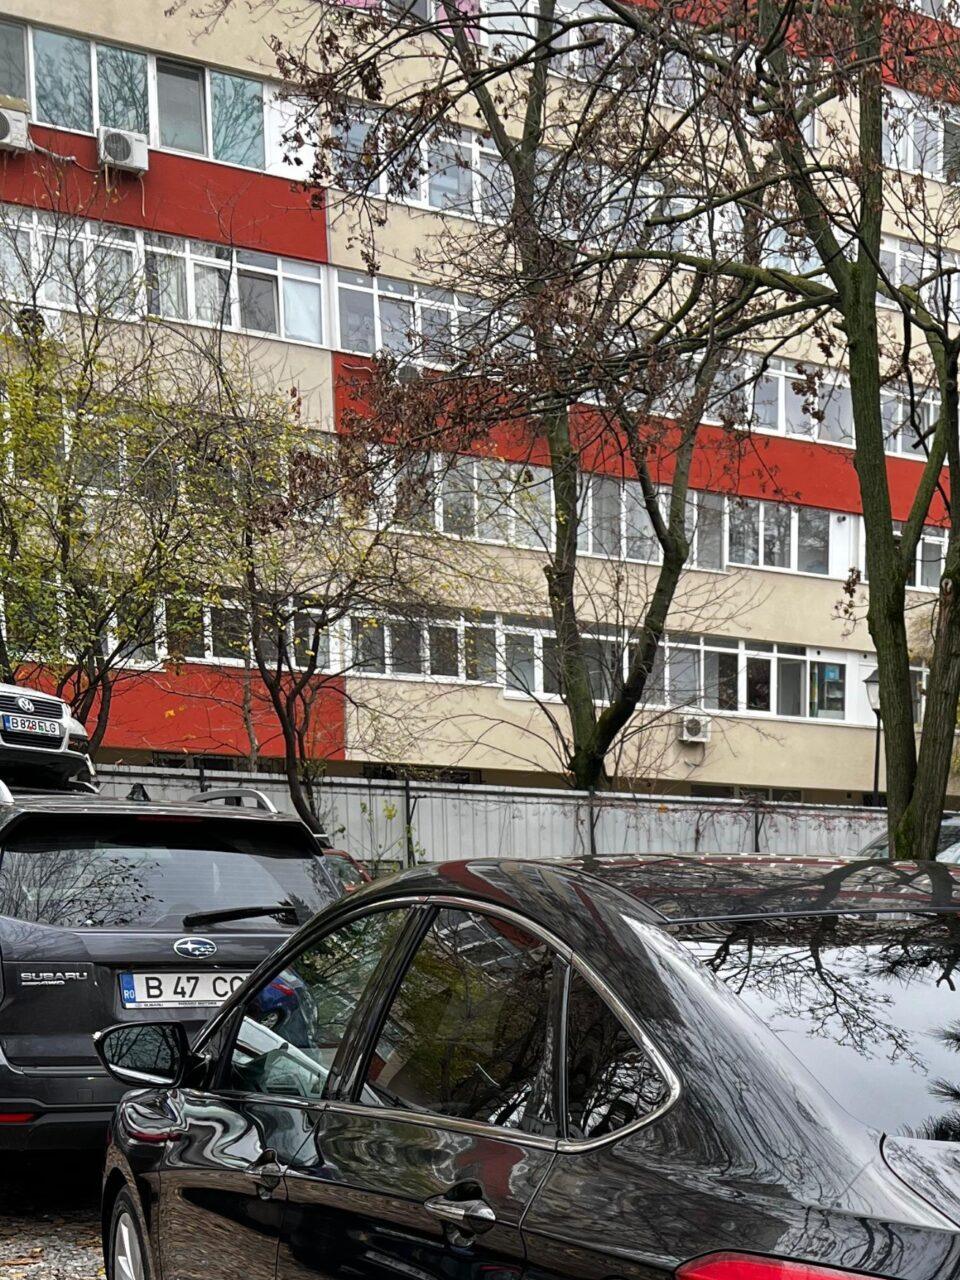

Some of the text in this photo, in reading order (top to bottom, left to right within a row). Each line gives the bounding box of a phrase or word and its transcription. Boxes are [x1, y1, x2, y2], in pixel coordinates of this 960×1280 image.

[12, 718, 19, 728] B
[20, 972, 88, 981] SUBARU
[145, 976, 163, 999] B
[173, 976, 200, 998] 47
[123, 989, 135, 999] RO
